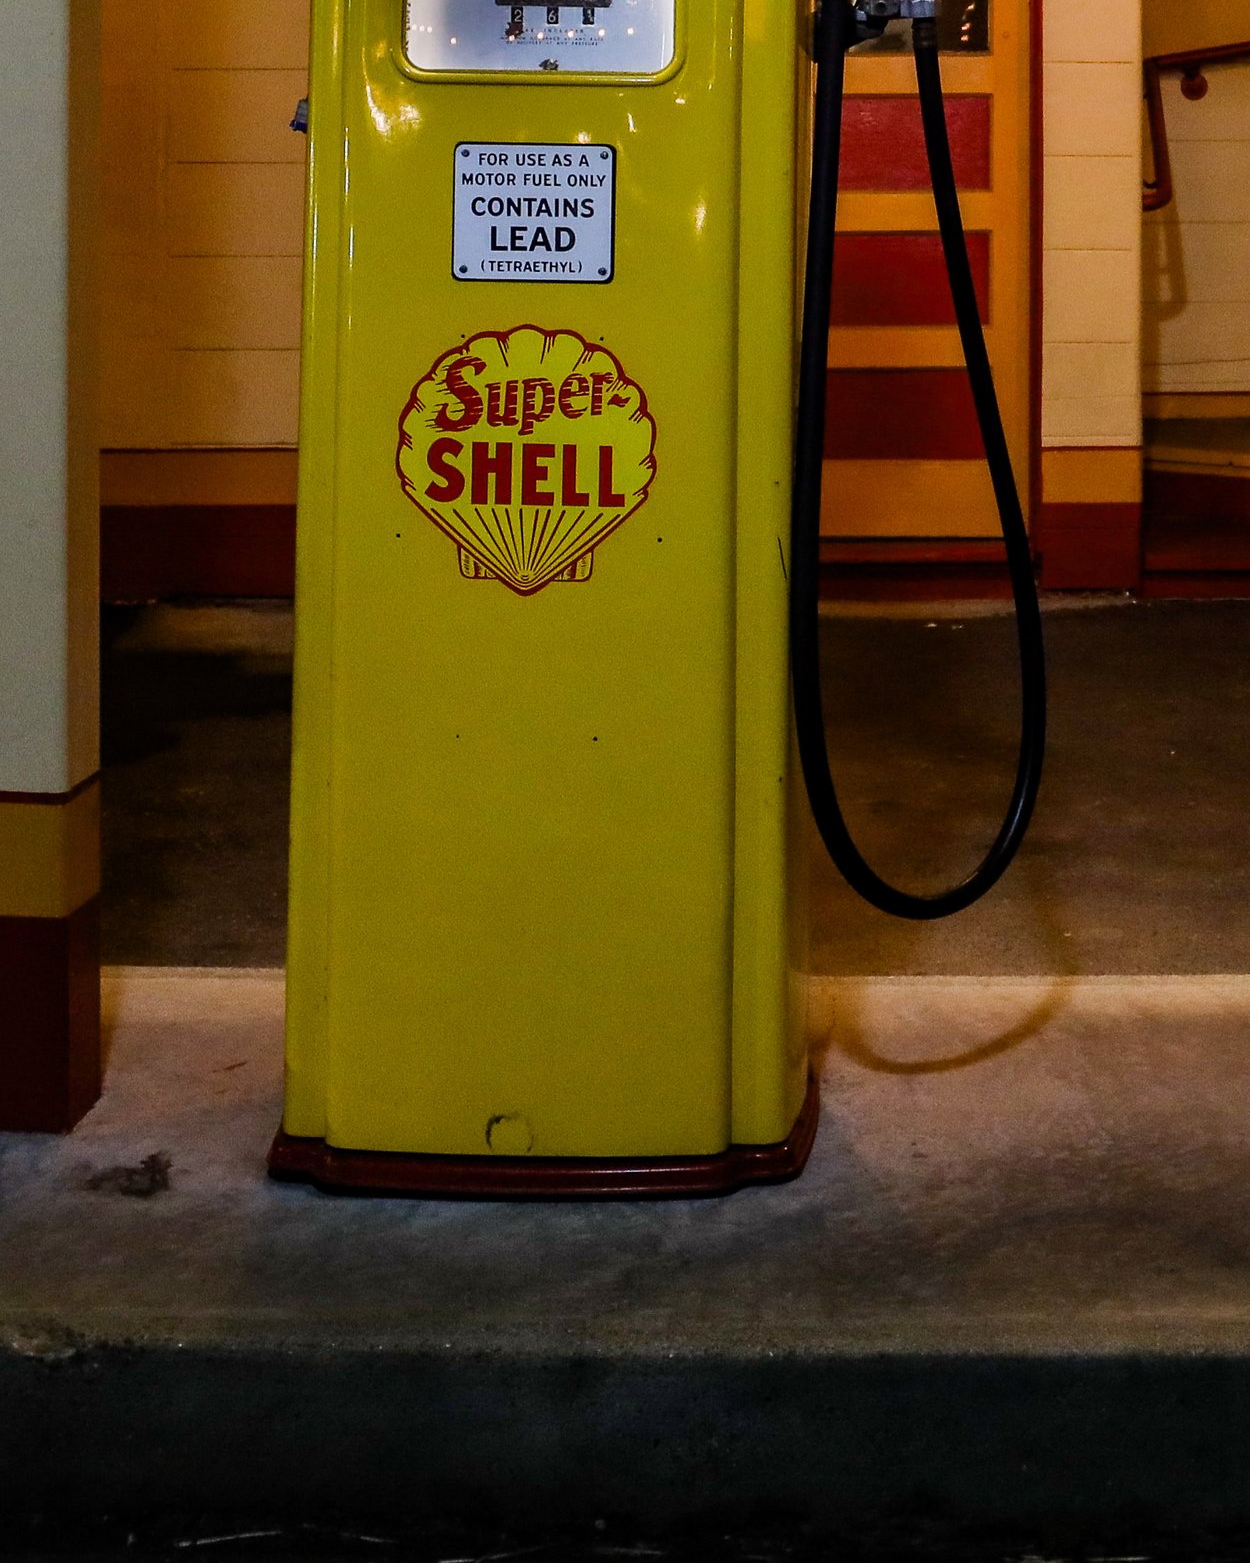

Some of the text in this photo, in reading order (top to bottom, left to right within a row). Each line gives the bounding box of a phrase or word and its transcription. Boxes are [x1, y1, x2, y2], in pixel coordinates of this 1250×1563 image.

[514, 9, 556, 23] 2 6
[478, 153, 590, 167] FOR USE AS A
[461, 172, 606, 187] MOTOR FUEL ONLY
[471, 196, 595, 218] CONTAINS
[490, 225, 576, 252] LEAD
[424, 437, 626, 508] SHELL
